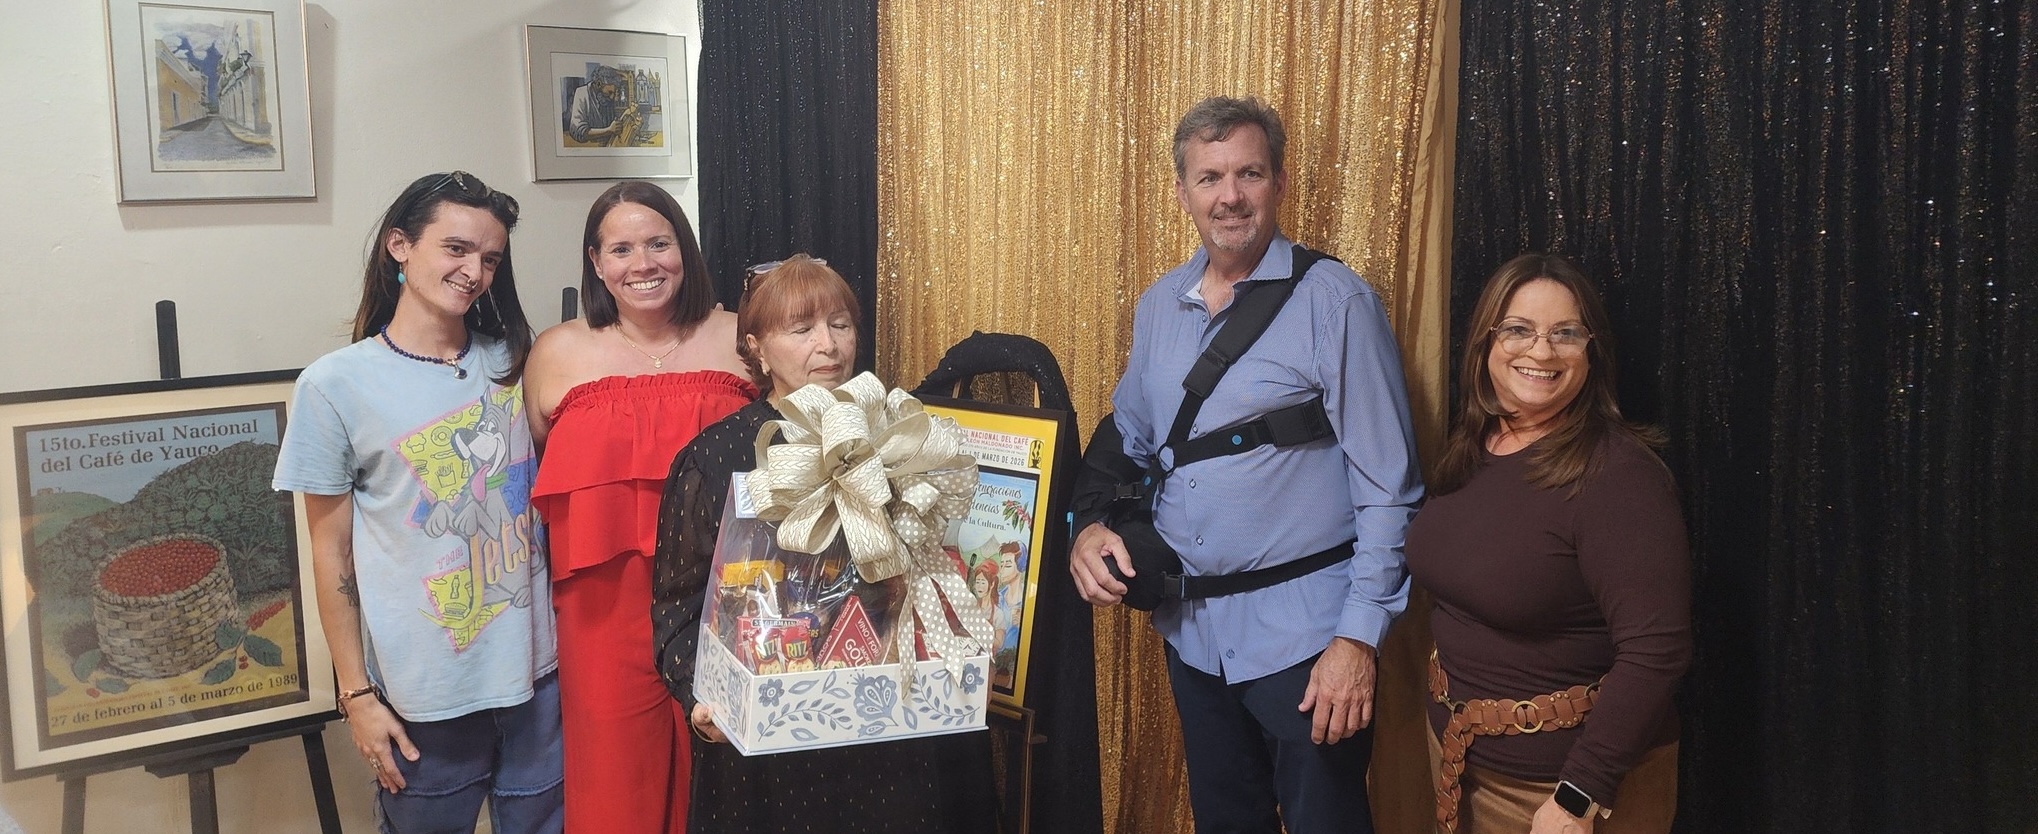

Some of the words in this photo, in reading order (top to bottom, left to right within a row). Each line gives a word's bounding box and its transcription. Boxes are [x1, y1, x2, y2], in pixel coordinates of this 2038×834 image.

[172, 419, 258, 442] Nacional
[971, 431, 999, 442] NACIONAL
[1002, 435, 1011, 443] DEL
[1014, 437, 1029, 446] CAFÉ
[981, 440, 1013, 450] MALDONADO
[41, 456, 71, 474] del
[79, 449, 124, 470] Café
[131, 449, 153, 464] de
[160, 443, 220, 461] Yauco
[982, 453, 1000, 463] MARZO
[1002, 455, 1009, 464] DE
[1010, 457, 1024, 466] 2026
[435, 545, 464, 570] THE
[857, 617, 870, 638] VINO
[786, 640, 808, 658] RITZ
[51, 714, 67, 727] 27
[73, 712, 90, 724] de
[95, 702, 145, 720] febrero
[150, 698, 162, 711] al
[168, 696, 176, 707] 5
[180, 693, 196, 704] de
[201, 685, 243, 701] marzo
[247, 681, 263, 692] de
[269, 673, 298, 688] 1989
